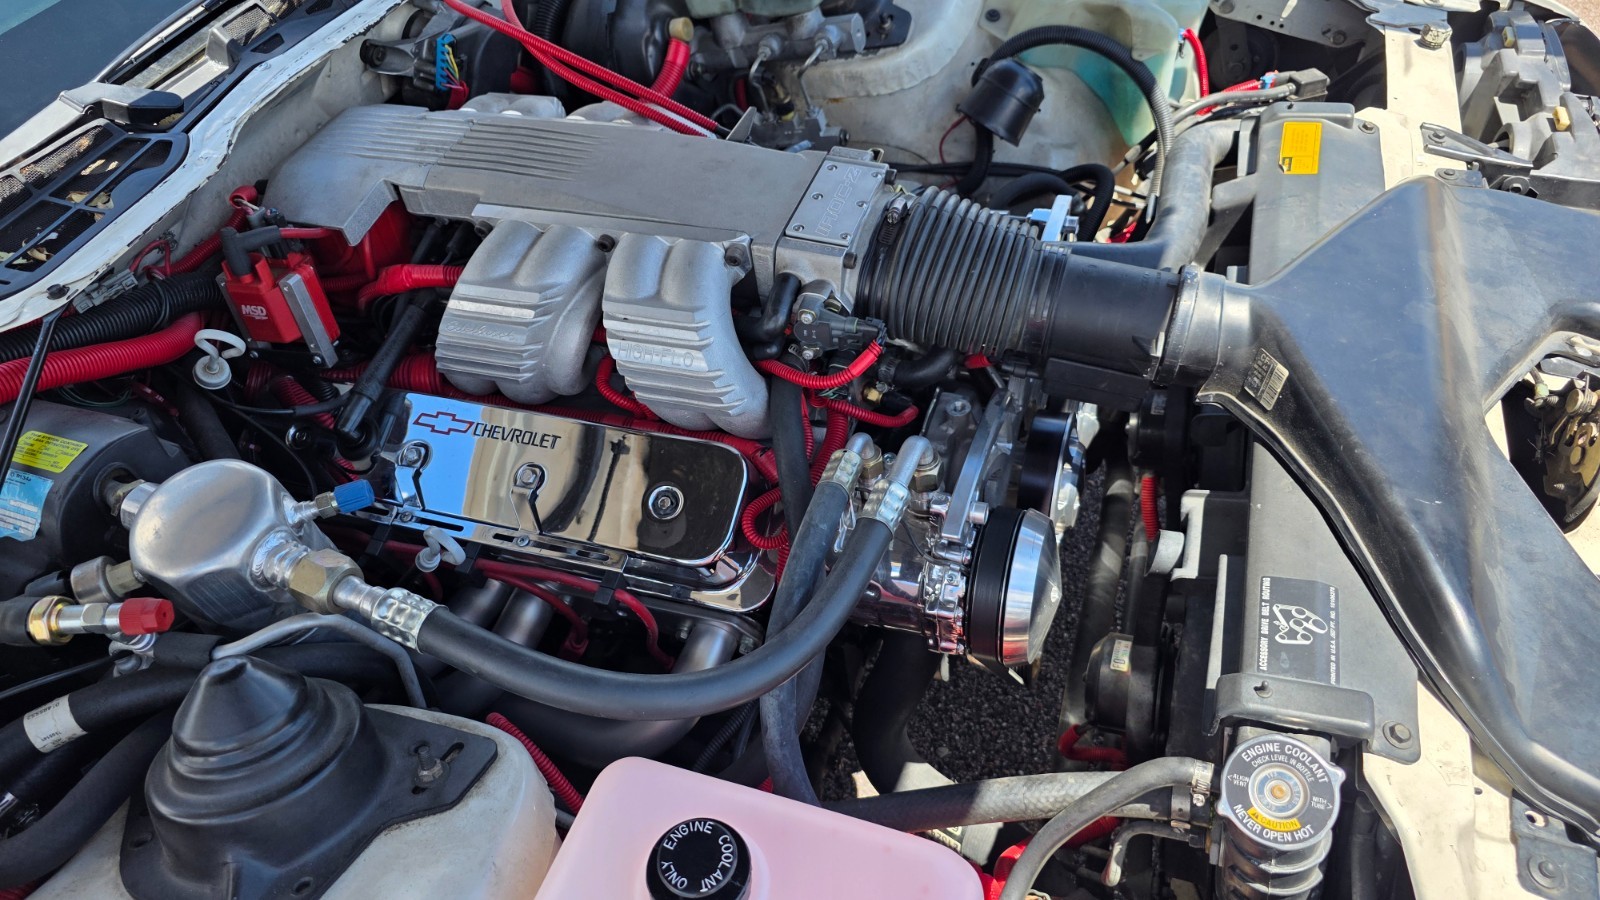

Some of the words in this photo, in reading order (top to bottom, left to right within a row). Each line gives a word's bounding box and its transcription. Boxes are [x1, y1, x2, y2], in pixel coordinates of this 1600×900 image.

[815, 166, 861, 237] IROC-Z
[241, 304, 267, 316] MSD
[473, 422, 562, 450] CHEVROLET
[1262, 577, 1271, 600] ROUTING
[1261, 602, 1270, 616] BELT
[1260, 618, 1270, 635] DRIVE
[1259, 636, 1269, 671] ACCESSORY
[1241, 742, 1280, 762] ENGINE
[1284, 744, 1328, 784] COOLANT
[1251, 755, 1270, 768] CHECK
[1270, 754, 1288, 763] LEVEL
[1289, 757, 1297, 767] IN
[1295, 762, 1315, 784] BOTTLE
[1232, 773, 1249, 783] ALIGN
[1233, 780, 1248, 788] VENT
[1310, 801, 1326, 810] TUBE
[1312, 796, 1327, 804] WITH
[1233, 804, 1260, 834] NEVER
[1262, 828, 1292, 842] OPEN
[1294, 824, 1315, 841] HOT
[1260, 814, 1298, 830] CAUTION
[662, 820, 714, 850] ENGINE
[661, 861, 688, 890] ONLY
[699, 834, 734, 892] COOLANT
